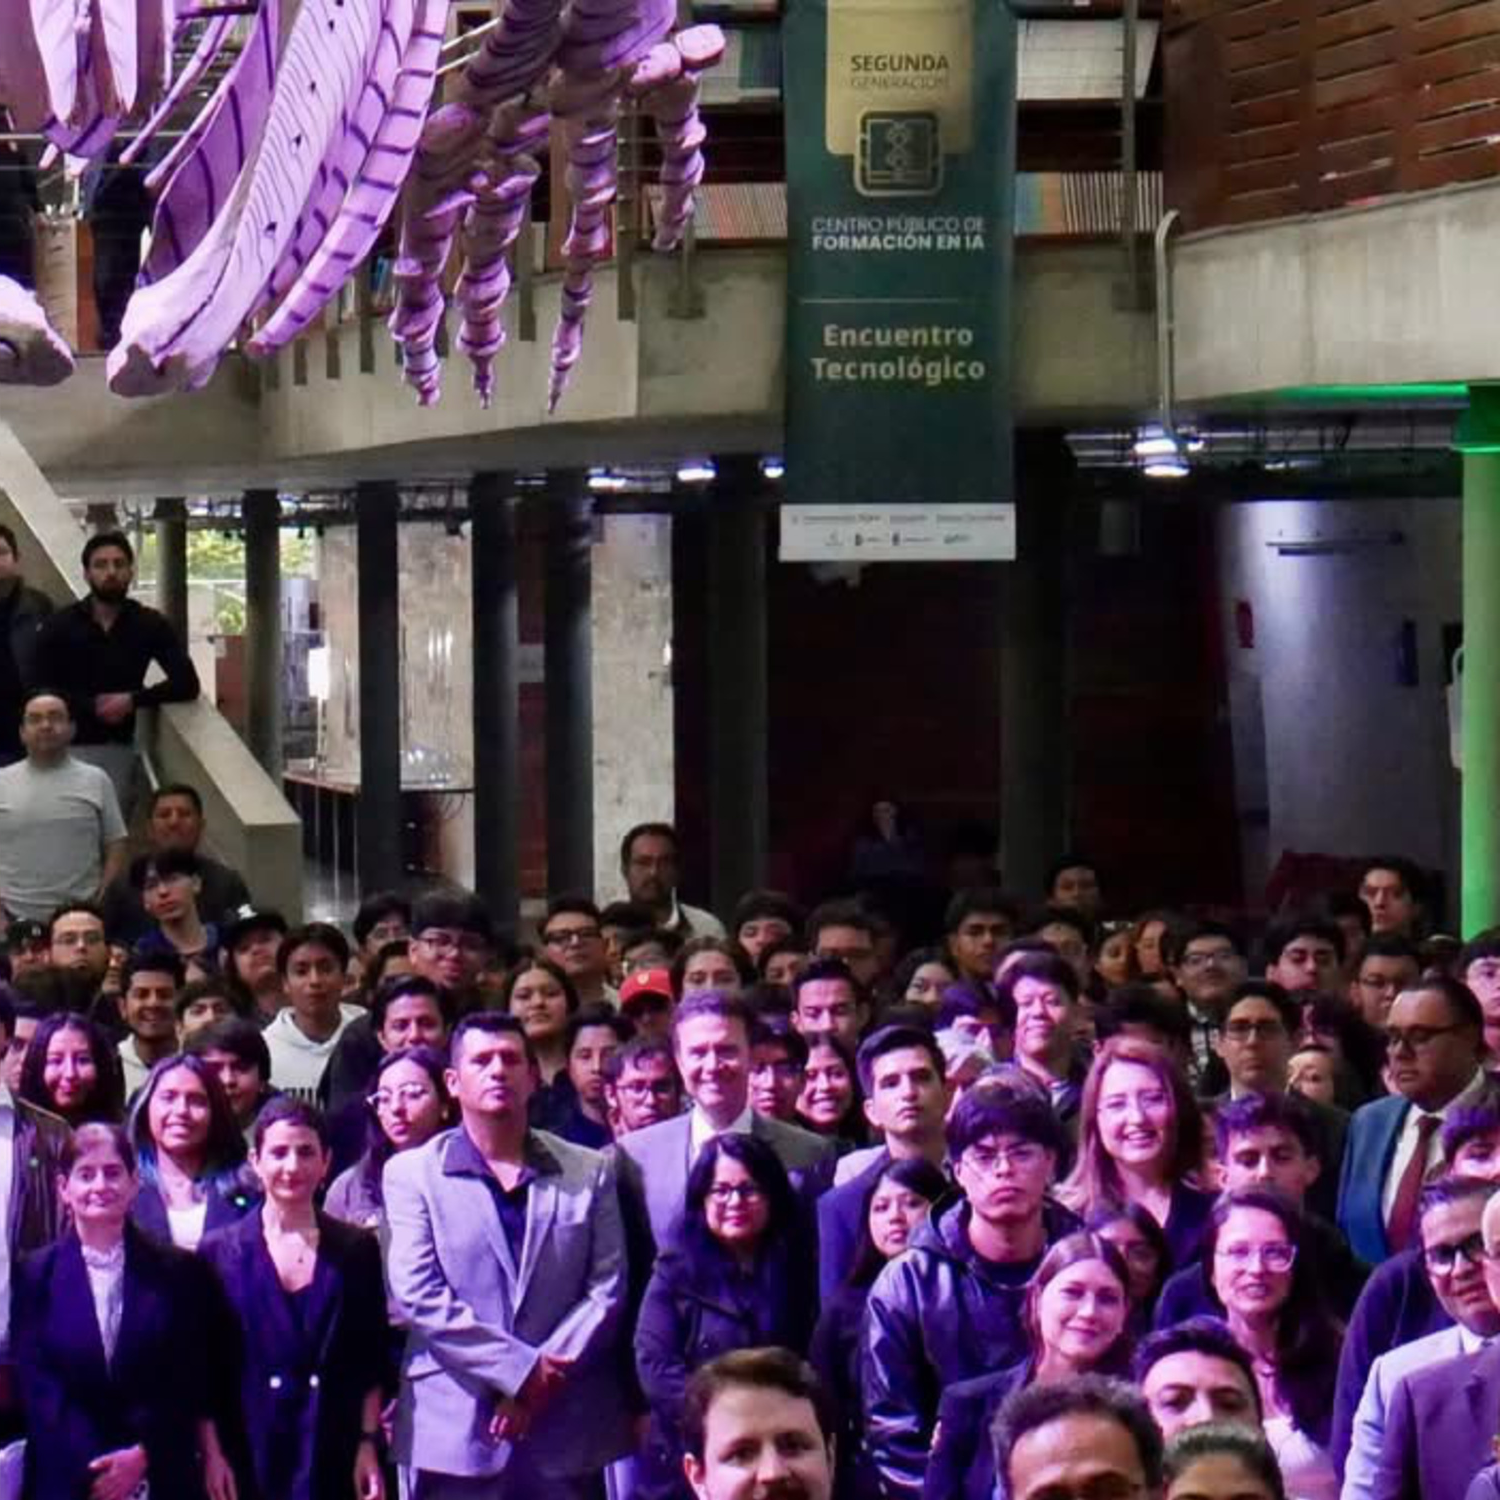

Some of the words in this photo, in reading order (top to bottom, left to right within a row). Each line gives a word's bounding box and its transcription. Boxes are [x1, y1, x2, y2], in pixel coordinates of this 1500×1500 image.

[850, 54, 950, 72] SEGUNDA
[811, 216, 883, 233] CENTRO
[886, 213, 960, 233] PÚBLICO
[964, 216, 986, 233] DE
[812, 230, 931, 251] FORMACIÓN
[936, 234, 961, 251] EN
[965, 234, 985, 251] IA
[823, 323, 973, 347] Encuentro
[810, 355, 986, 386] Tecnológico
